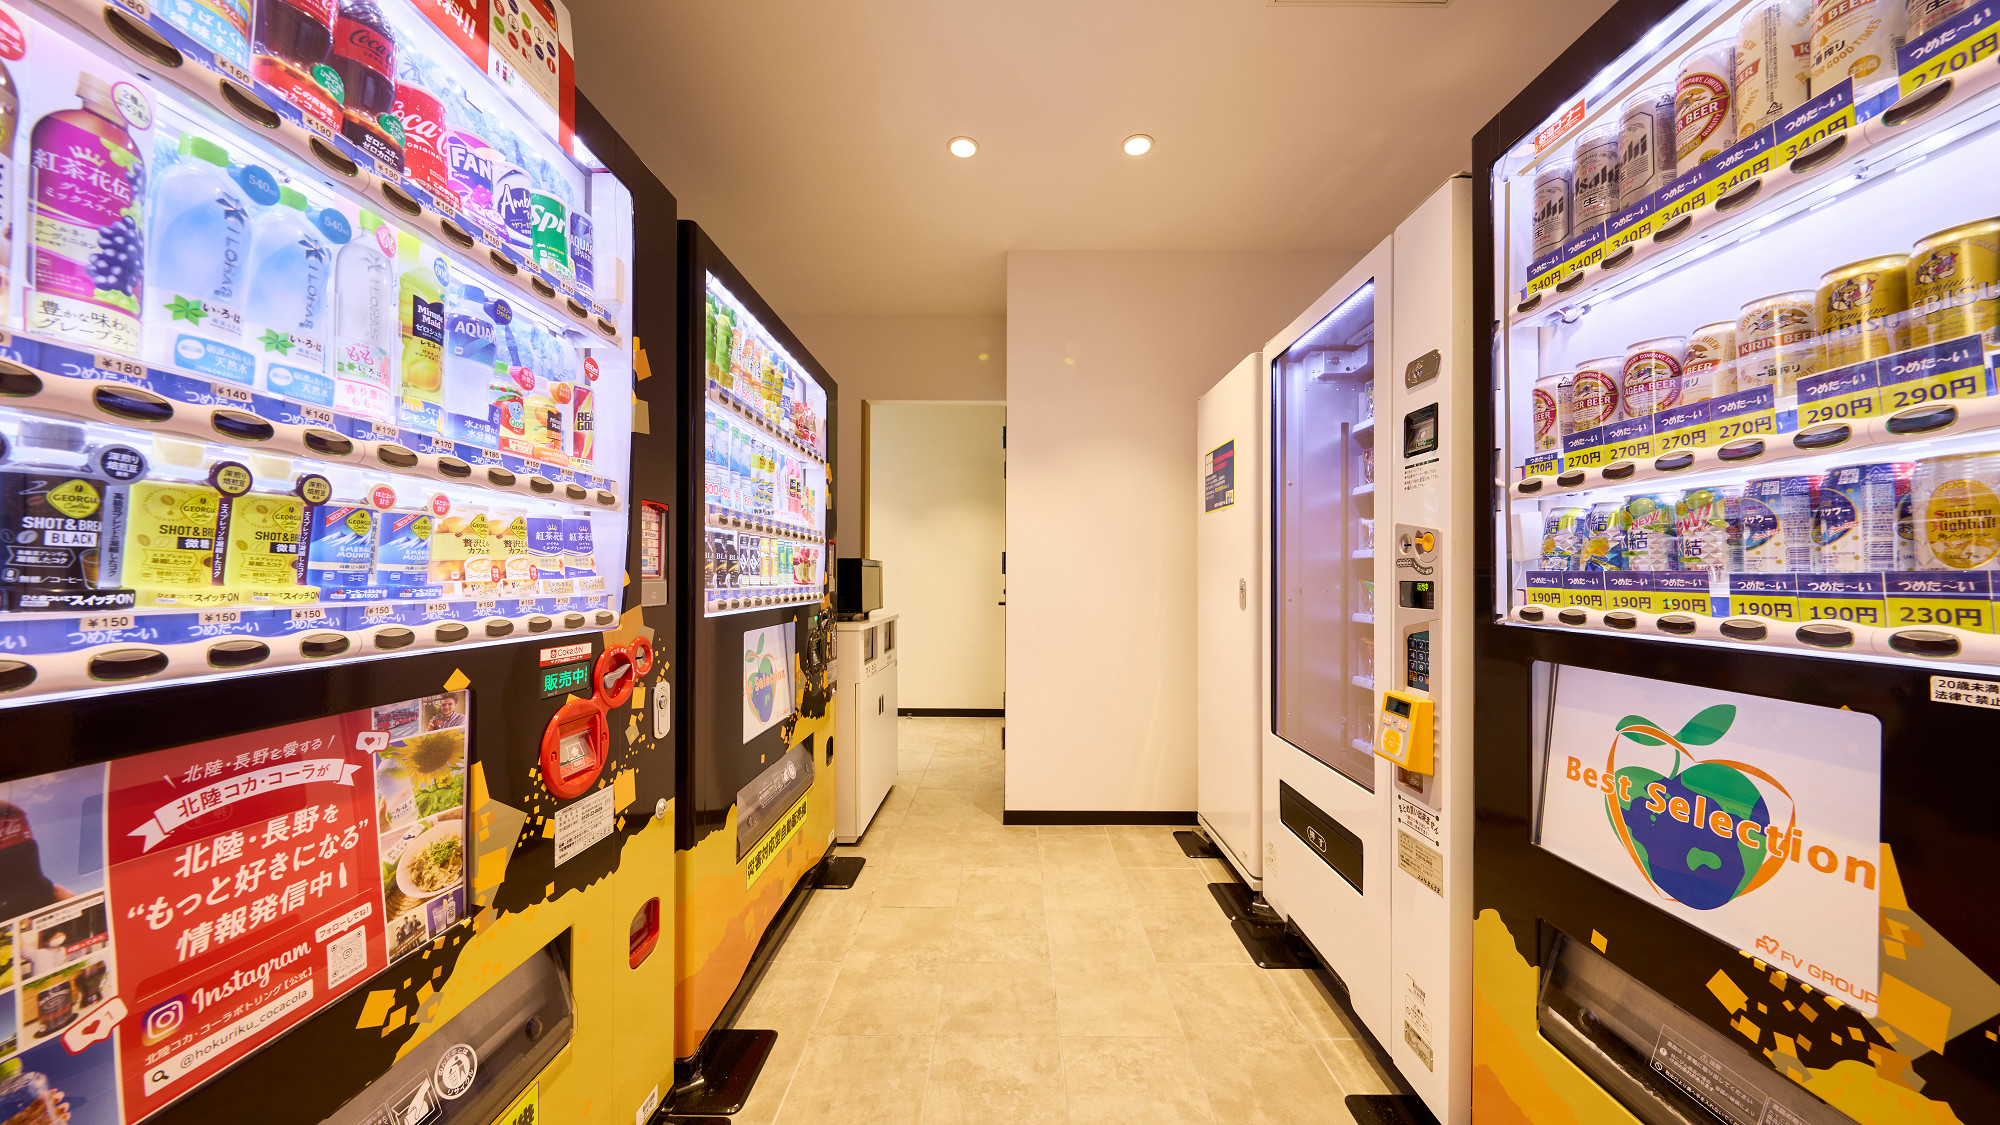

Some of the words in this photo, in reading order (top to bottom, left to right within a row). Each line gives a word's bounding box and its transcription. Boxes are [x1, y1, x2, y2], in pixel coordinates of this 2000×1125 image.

[1826, 45, 1855, 69] GOOD
[1855, 18, 1882, 45] TIMES
[1811, 40, 1845, 69] 一番搾り
[1851, 58, 1878, 74] お酒
[1685, 102, 1720, 124] BEER
[1701, 112, 1722, 138] QUALITY
[33, 148, 131, 203] 紅茶花伝
[58, 181, 113, 203] グレープ
[1583, 196, 1597, 208] 生
[1911, 276, 1976, 299] Premium
[1823, 305, 1887, 327] Premium
[1702, 335, 1721, 350] BREW
[1740, 338, 1778, 355] KIRIN
[102, 358, 142, 375] ¥180
[1687, 361, 1714, 375] BEER
[1756, 364, 1801, 377] 一番搾り
[1648, 379, 1677, 391] BEER
[1893, 376, 1977, 410] 290円
[217, 387, 247, 401] ¥140
[1586, 395, 1611, 407] BEER
[305, 408, 330, 422] ¥140
[1807, 397, 1873, 424] 290円
[1719, 416, 1773, 440] 270円
[1662, 429, 1706, 450] 270円
[1568, 451, 1601, 468] 270円
[1610, 442, 1650, 460] 270円
[53, 493, 99, 503] GEORGIA
[1933, 508, 1993, 521] Suntory
[1591, 515, 1609, 533] 結
[51, 533, 94, 545] BLACK
[184, 538, 210, 550] 微糖
[1629, 530, 1648, 550] 結
[1685, 538, 1702, 557] 結
[276, 543, 297, 553] 微糖
[1532, 592, 1561, 604] 190円
[1569, 595, 1602, 607] 190円
[1612, 597, 1651, 610] 190円
[1663, 599, 1706, 613] 190円
[295, 610, 321, 618] ¥150
[368, 606, 389, 614] ¥150
[429, 603, 447, 611] ¥150
[1738, 602, 1793, 619] 190円
[1810, 606, 1878, 624] 190円
[87, 616, 129, 629] ¥150
[205, 612, 236, 622] ¥150
[1900, 606, 1982, 628] 230円
[557, 647, 573, 658] Coke
[755, 670, 786, 692] Selection
[181, 738, 323, 784] 北陸・長野を愛する
[177, 763, 331, 820] 北陸コカ・コーラが
[1566, 756, 1632, 803] Best
[1645, 781, 1878, 892] Selection
[173, 803, 340, 879] 北陸・長野を
[175, 870, 333, 962] 情報発信中
[191, 942, 312, 1014] Instagram
[1780, 949, 1804, 971] FV
[1808, 963, 1879, 1006] GROUP
[180, 989, 308, 1069] @hokuriku_cocacola
